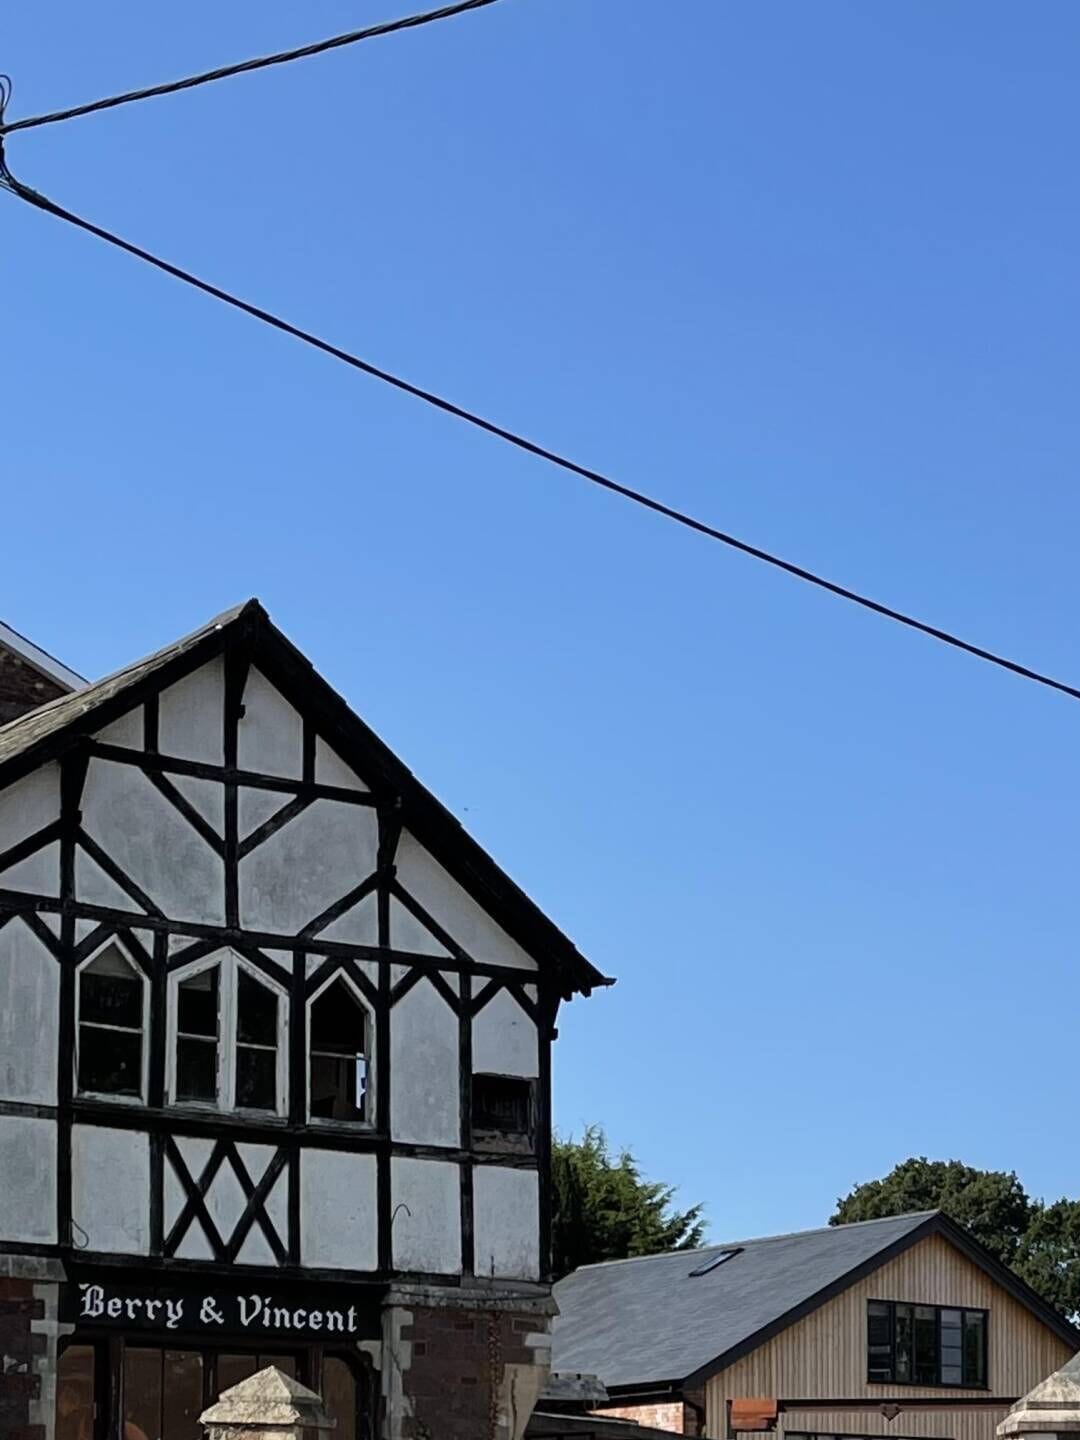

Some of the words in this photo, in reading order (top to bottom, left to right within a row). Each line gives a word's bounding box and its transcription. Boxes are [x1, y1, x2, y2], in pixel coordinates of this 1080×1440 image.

[78, 1283, 184, 1329] Berry
[199, 1296, 225, 1325] &
[237, 1294, 358, 1333] Vincent
